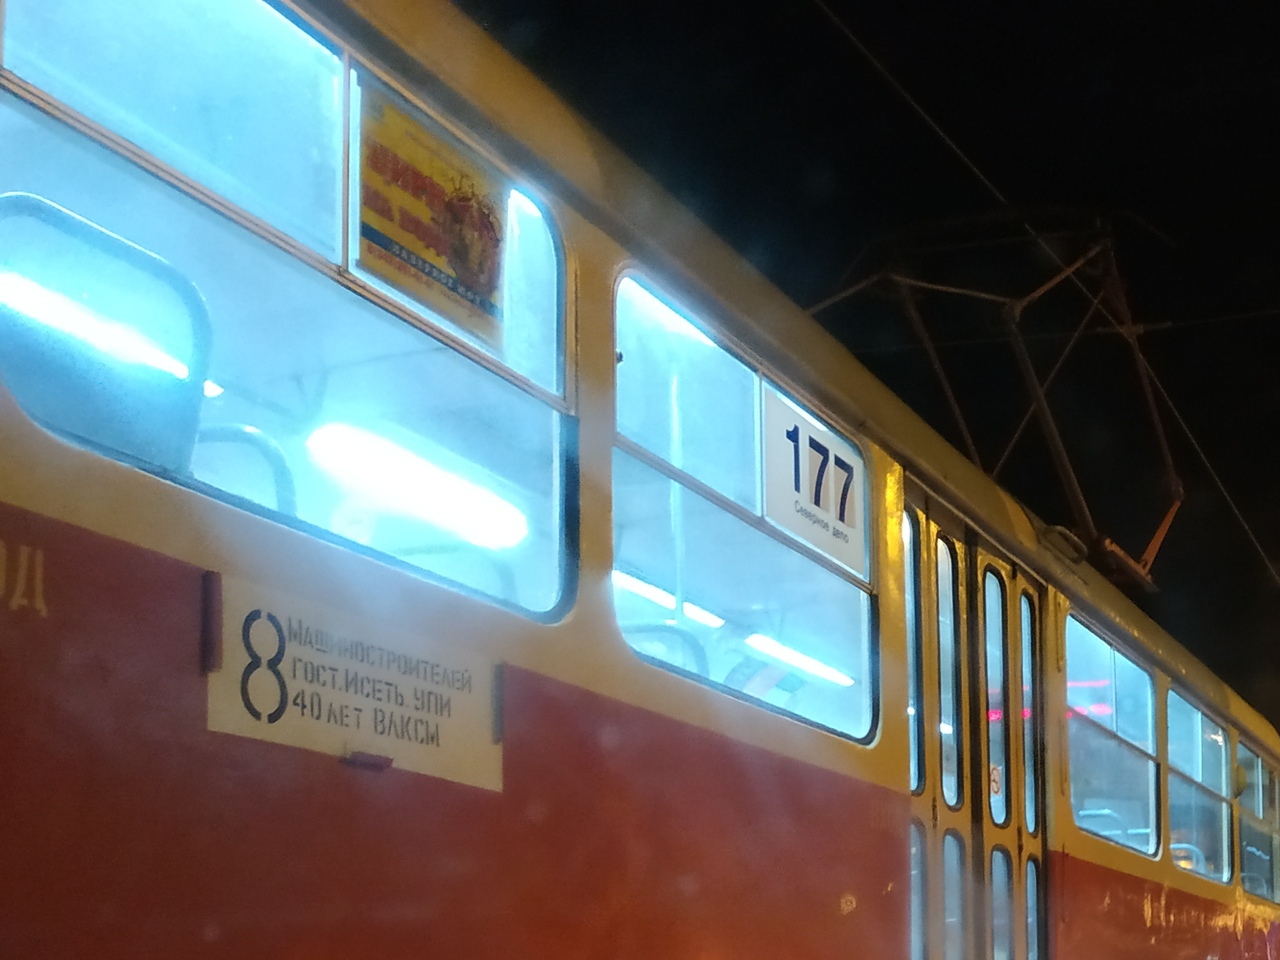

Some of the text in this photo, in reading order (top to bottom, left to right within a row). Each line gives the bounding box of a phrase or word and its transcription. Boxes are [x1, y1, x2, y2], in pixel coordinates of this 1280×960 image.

[786, 424, 854, 524] 177
[241, 609, 288, 724] 8
[292, 689, 440, 748] 40 ЛЕТ ВЛКСМ
